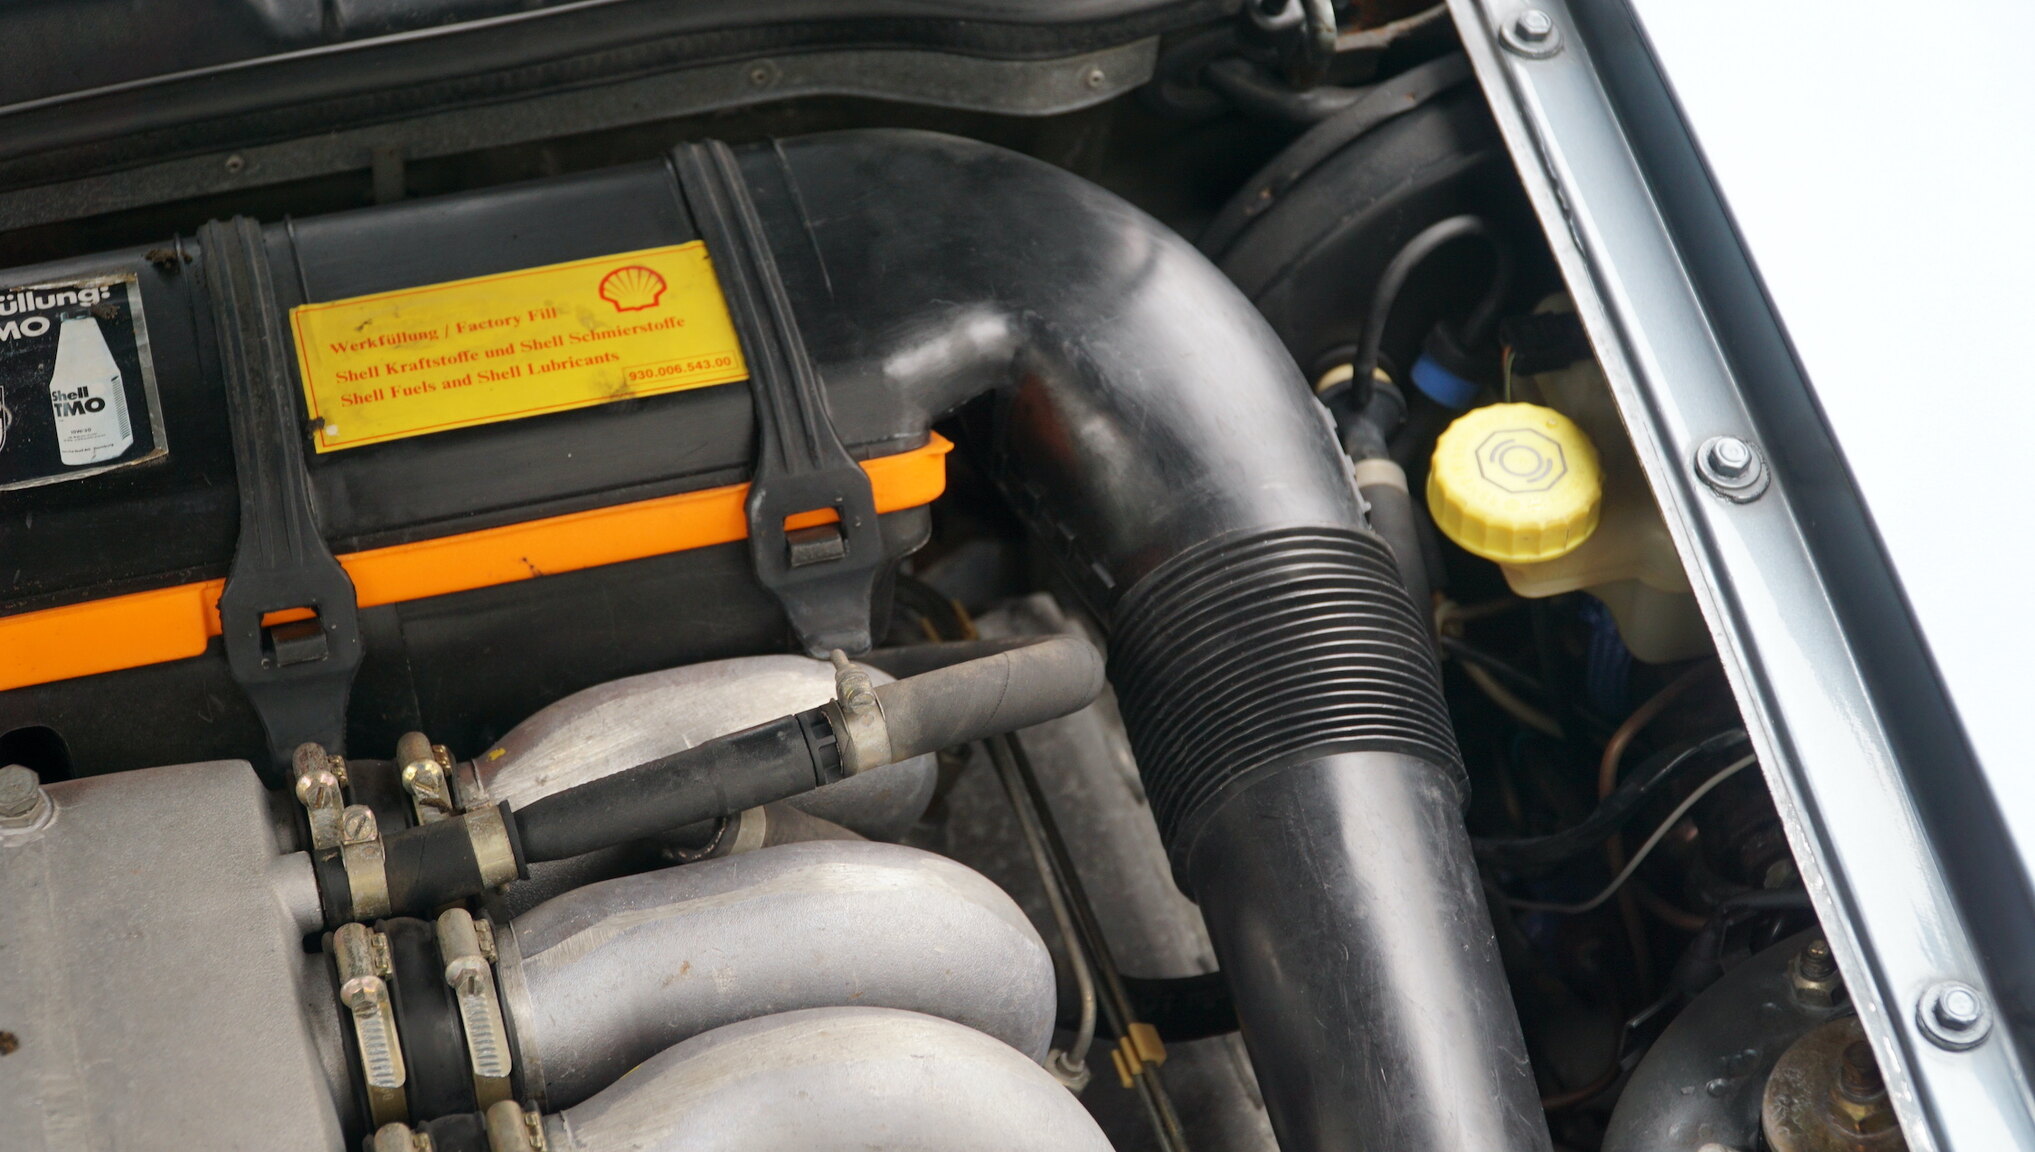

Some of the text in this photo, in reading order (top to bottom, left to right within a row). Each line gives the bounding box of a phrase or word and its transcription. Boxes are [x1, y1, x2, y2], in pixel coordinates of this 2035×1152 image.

[329, 306, 557, 355] Werkfüllung / Factory Fill
[335, 316, 686, 384] Shell Kraftstoffe und Shell Schmierstoffe
[628, 356, 732, 381] 930.006.543.00
[51, 385, 89, 401] Shell
[340, 351, 620, 408] Shell Fuels and Shell Lubricants
[54, 397, 106, 418] TMO
